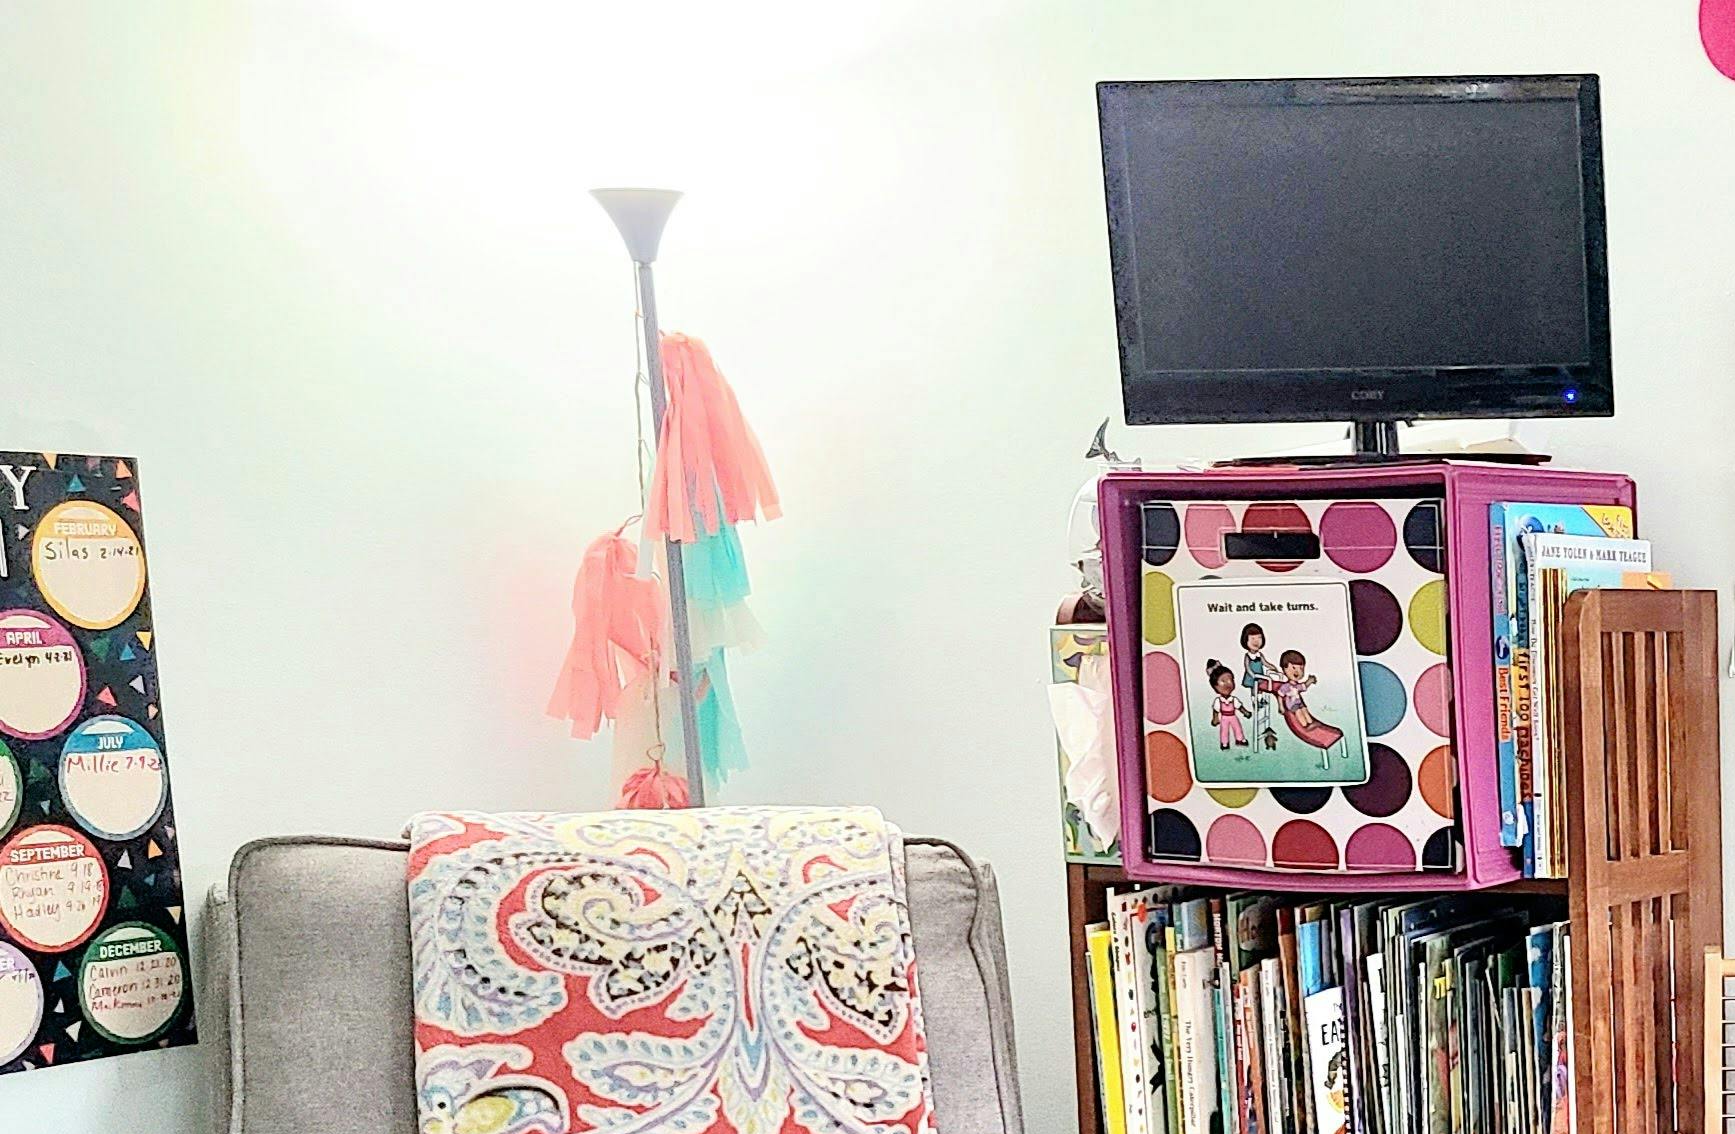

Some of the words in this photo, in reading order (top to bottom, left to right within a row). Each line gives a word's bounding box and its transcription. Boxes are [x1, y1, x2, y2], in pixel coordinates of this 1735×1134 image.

[55, 522, 117, 536] FEBRUARY
[45, 537, 89, 561] Silas
[1541, 545, 1562, 558] JANE
[1563, 547, 1588, 559] YOLEN
[1596, 549, 1618, 562] MARK
[1619, 551, 1647, 564] TEAGUE
[1207, 603, 1233, 613] Wait
[1236, 602, 1256, 612] and
[1259, 601, 1284, 612] take
[1287, 601, 1319, 611] turns.
[5, 631, 43, 645] APRIL
[1498, 667, 1510, 694] Best
[1518, 651, 1531, 690] first
[1499, 697, 1511, 741] Friends
[97, 735, 124, 750] JULY
[10, 843, 86, 863] SEPTEMBER
[99, 939, 162, 959] DECEMBER
